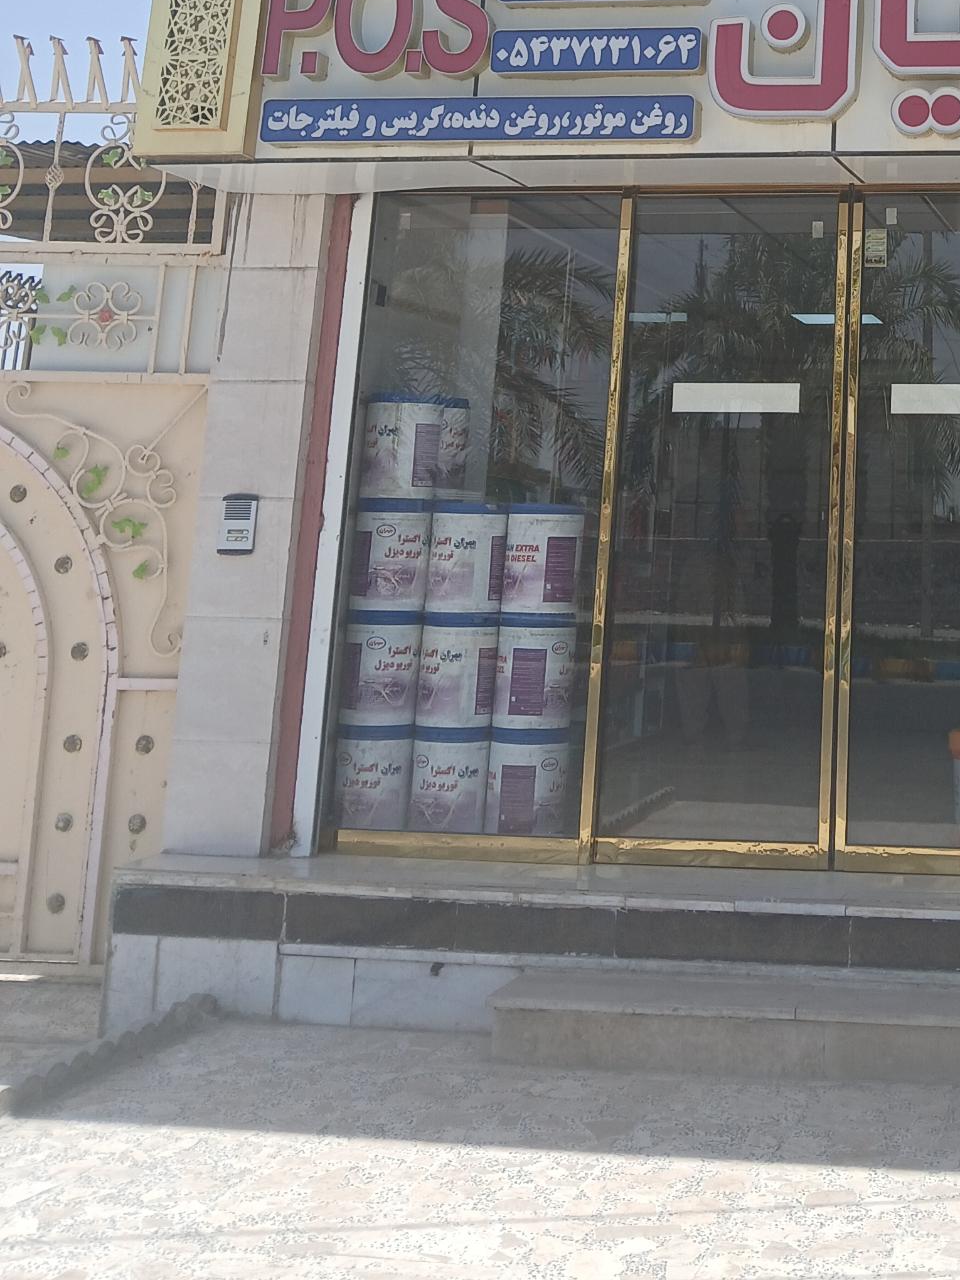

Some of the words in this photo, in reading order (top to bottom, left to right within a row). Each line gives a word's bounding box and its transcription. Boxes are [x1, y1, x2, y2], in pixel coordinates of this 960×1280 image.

[495, 33, 697, 67] ۰۵۴۳۷۲۳۱۰۶۴
[362, 115, 376, 137] و
[630, 103, 688, 135] روغن
[511, 554, 537, 563] DIESEL
[515, 544, 540, 553] EXTRA
